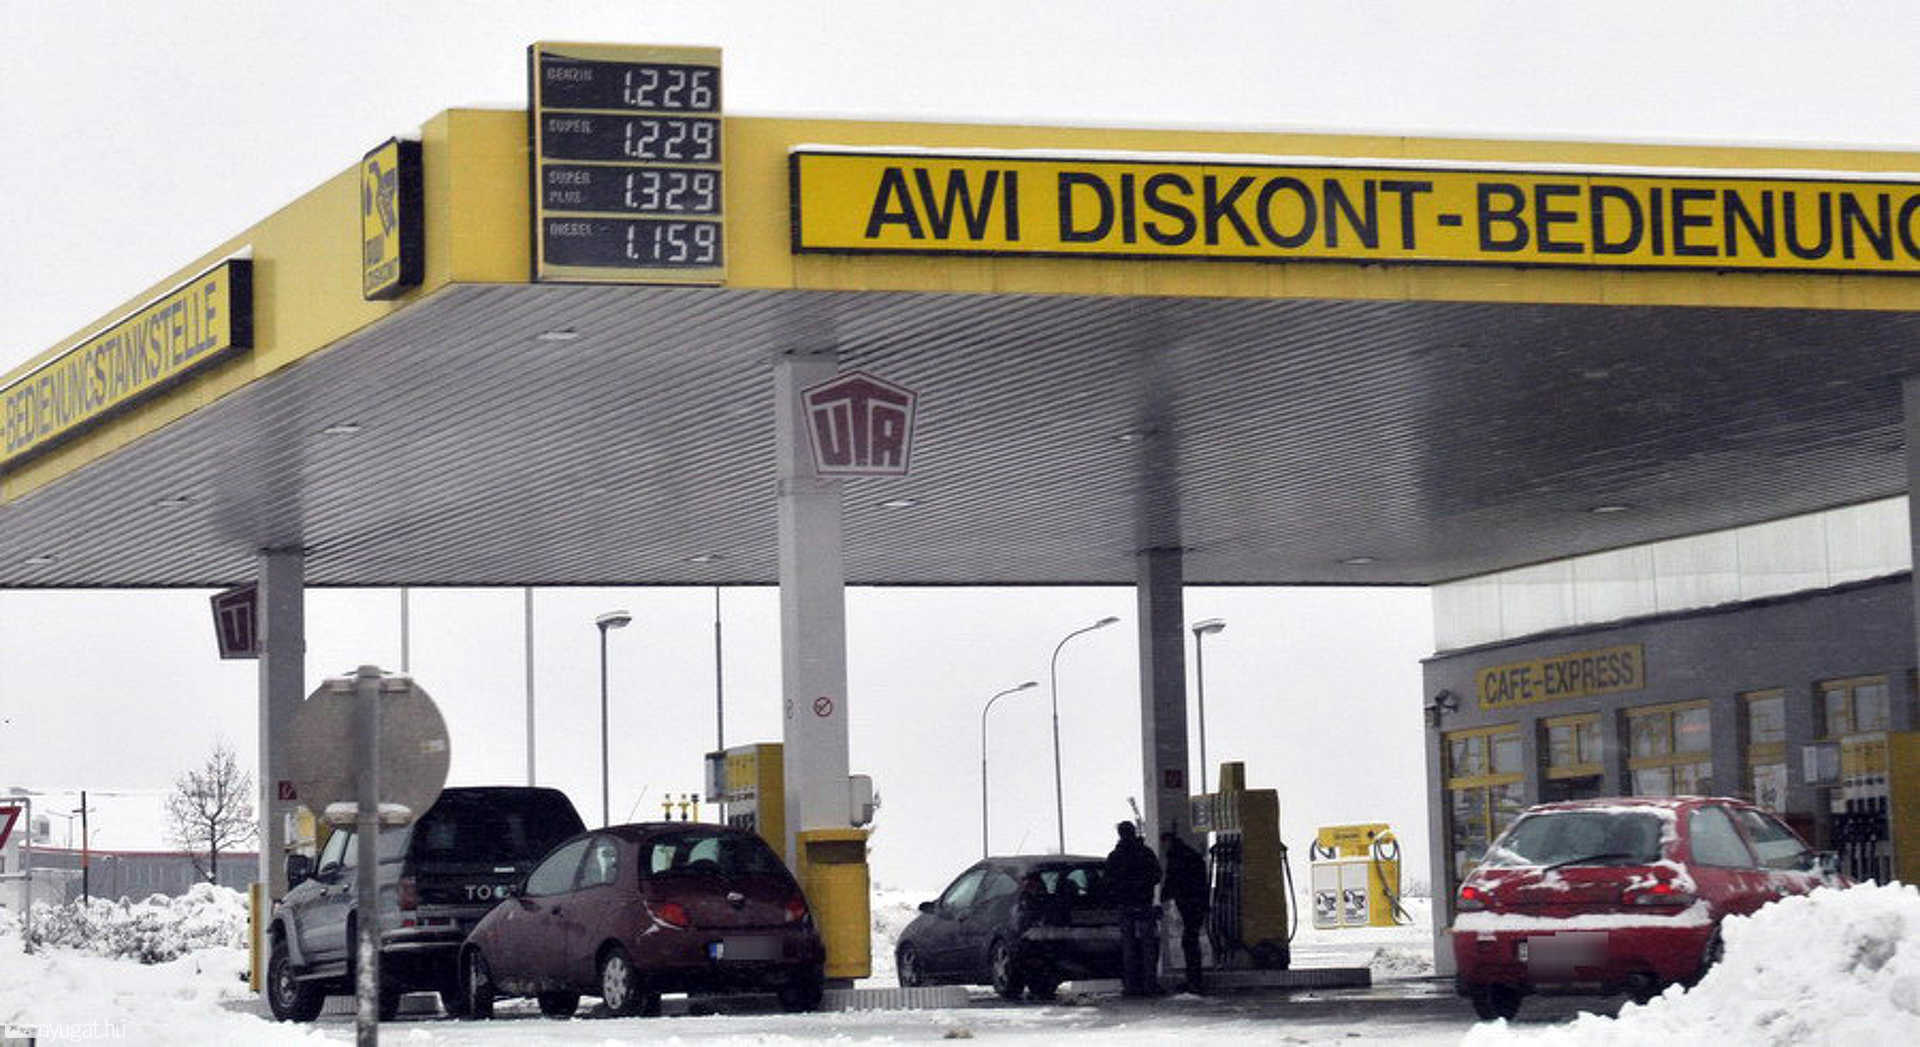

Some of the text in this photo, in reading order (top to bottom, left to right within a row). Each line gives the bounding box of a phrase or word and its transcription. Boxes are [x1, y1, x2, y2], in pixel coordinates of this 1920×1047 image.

[624, 69, 712, 108] 1.226
[548, 119, 713, 159] SUPER 1.229
[548, 170, 714, 211] SUPER 1.329
[548, 191, 580, 204] PLUS
[865, 167, 1020, 241] AWI
[626, 224, 716, 263] 1.159
[809, 378, 908, 468] UTA
[1485, 652, 1634, 704] CAFE-EXPRESS
